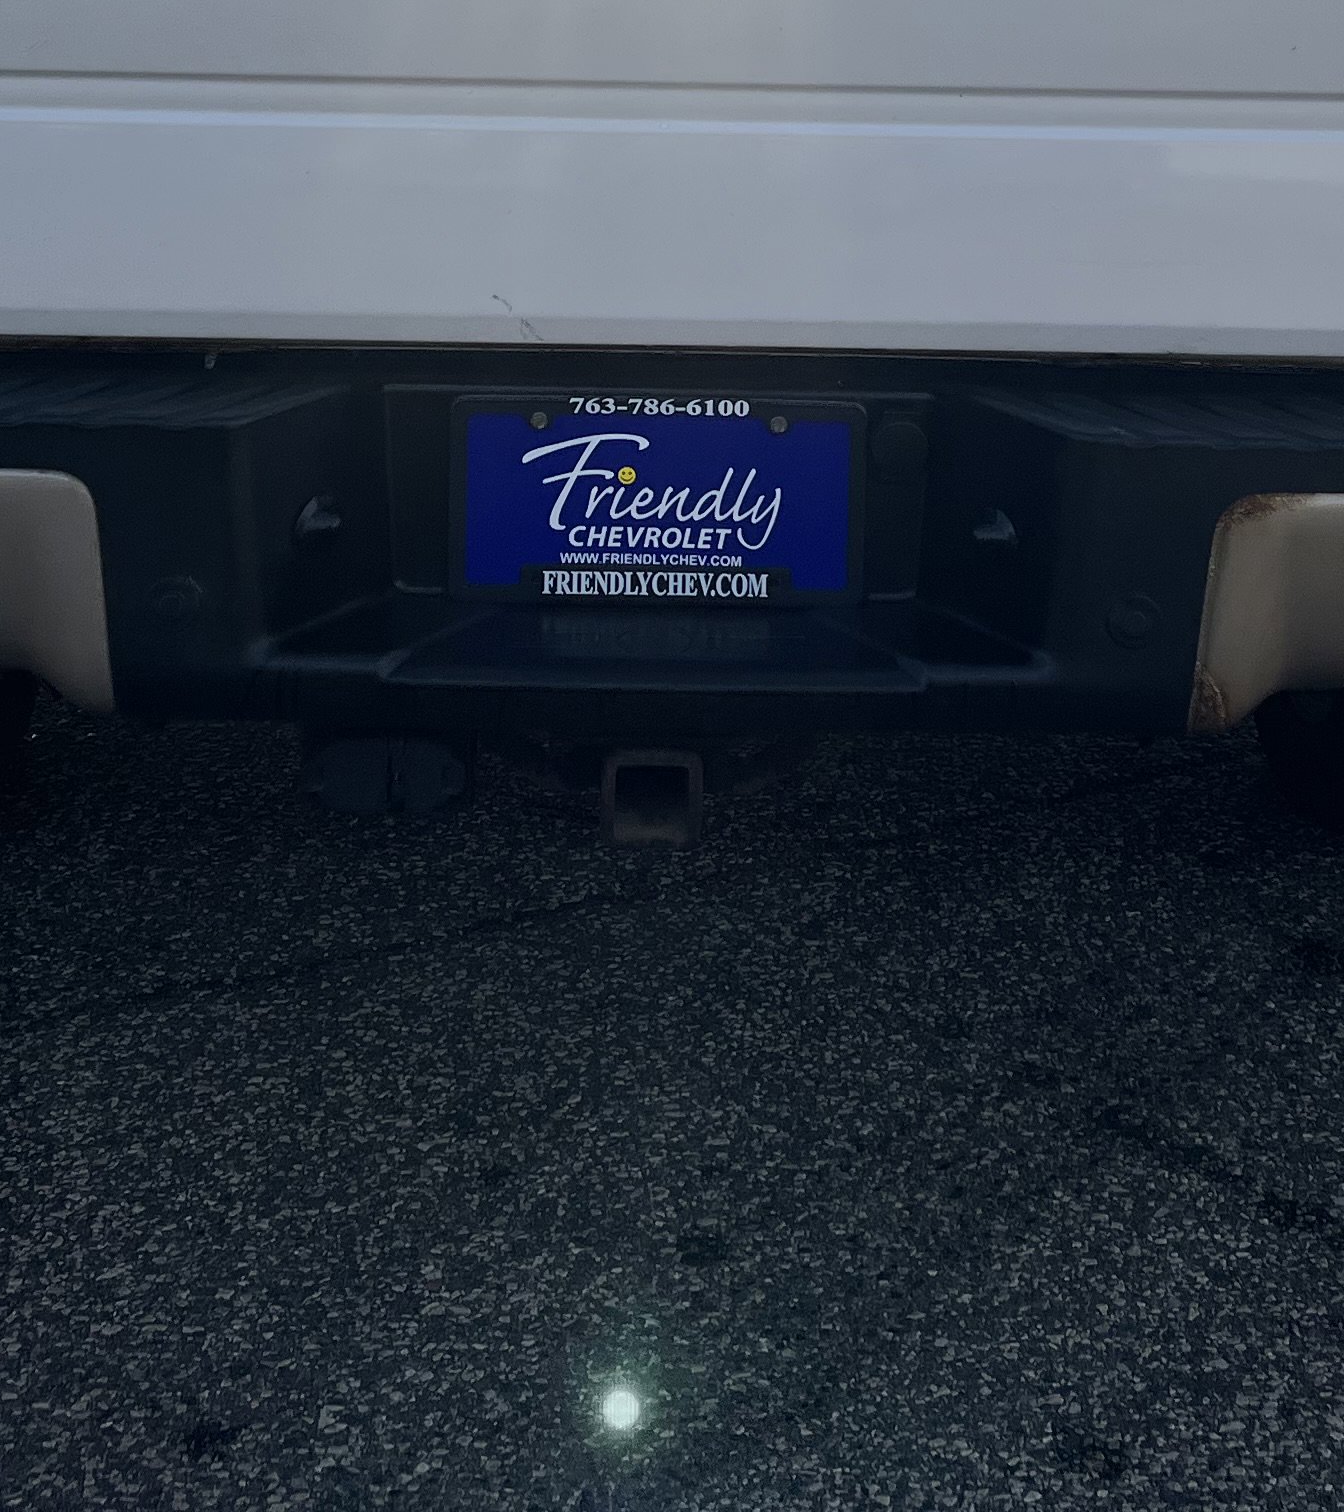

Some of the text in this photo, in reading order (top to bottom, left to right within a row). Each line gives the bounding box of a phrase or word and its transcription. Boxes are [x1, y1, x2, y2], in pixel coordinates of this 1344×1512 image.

[570, 398, 750, 417] 763-786-6100
[521, 433, 782, 550] Friendly
[568, 525, 732, 550] CHEVROLET
[560, 552, 742, 567] WWW.FRIENDLYCHEV.COM
[542, 570, 768, 598] FRIENDLYCHEV.COM
